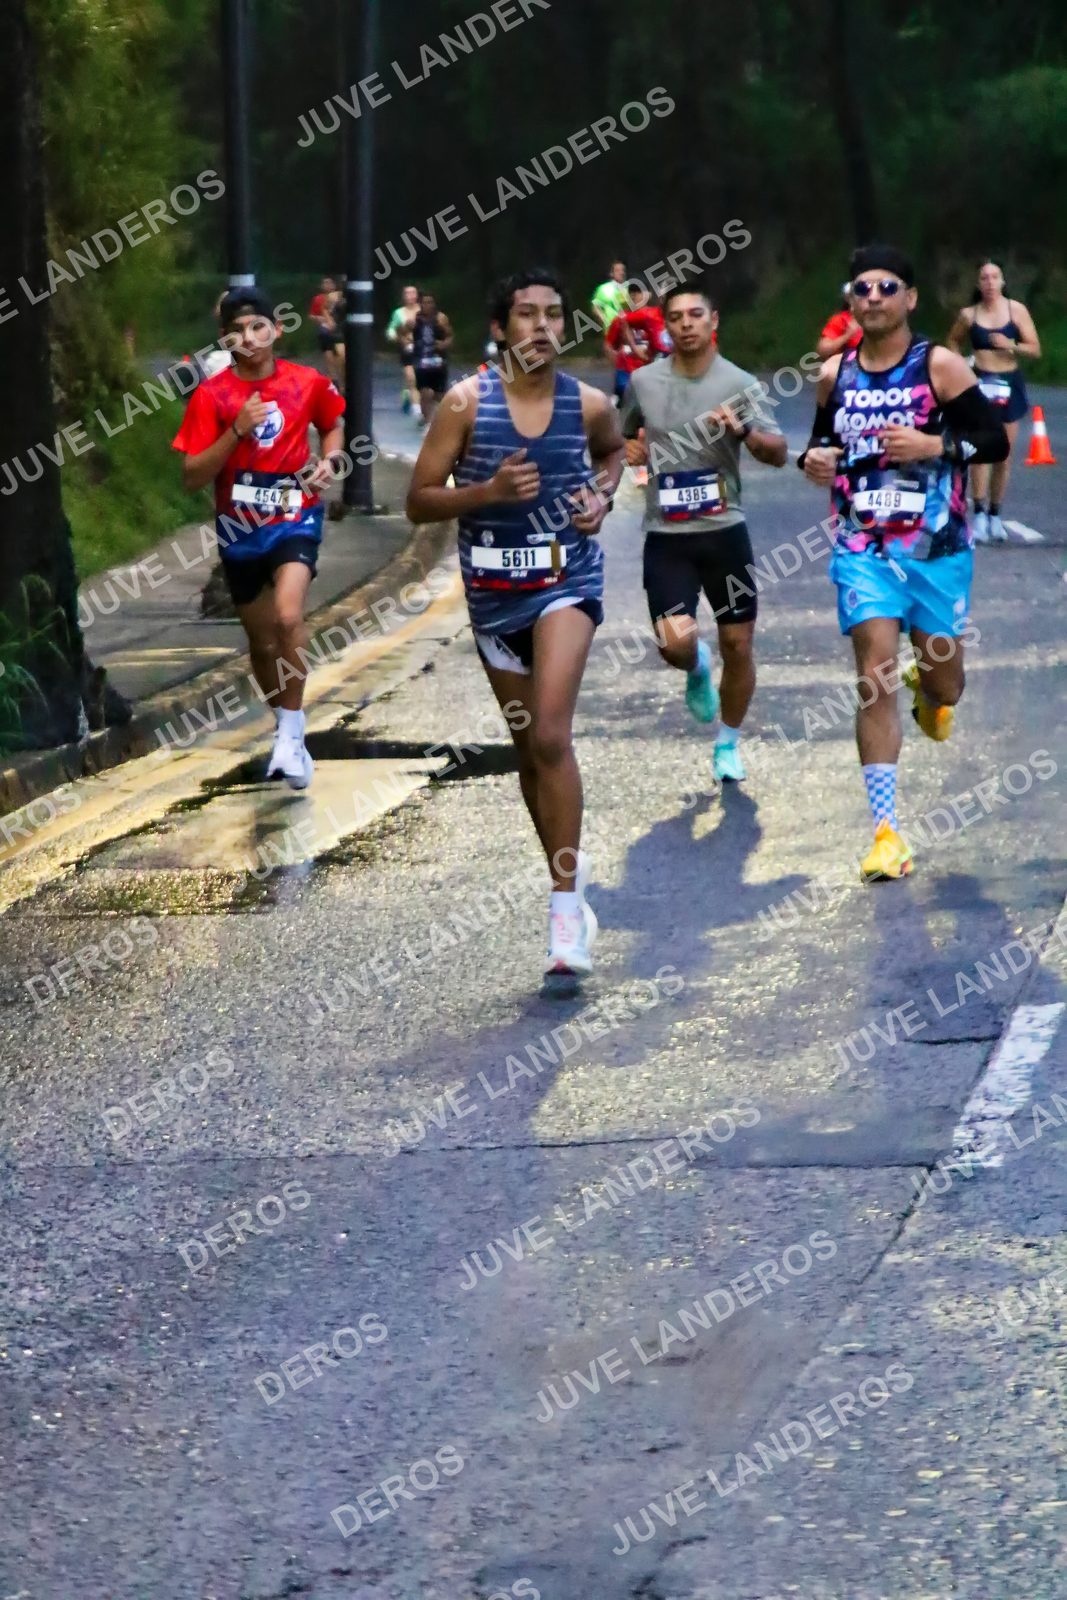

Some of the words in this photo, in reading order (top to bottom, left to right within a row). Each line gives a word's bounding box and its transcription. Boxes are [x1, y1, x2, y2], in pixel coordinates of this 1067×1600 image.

[844, 388, 912, 408] TODOS
[678, 486, 708, 502] 4385
[502, 549, 536, 567] 5611
